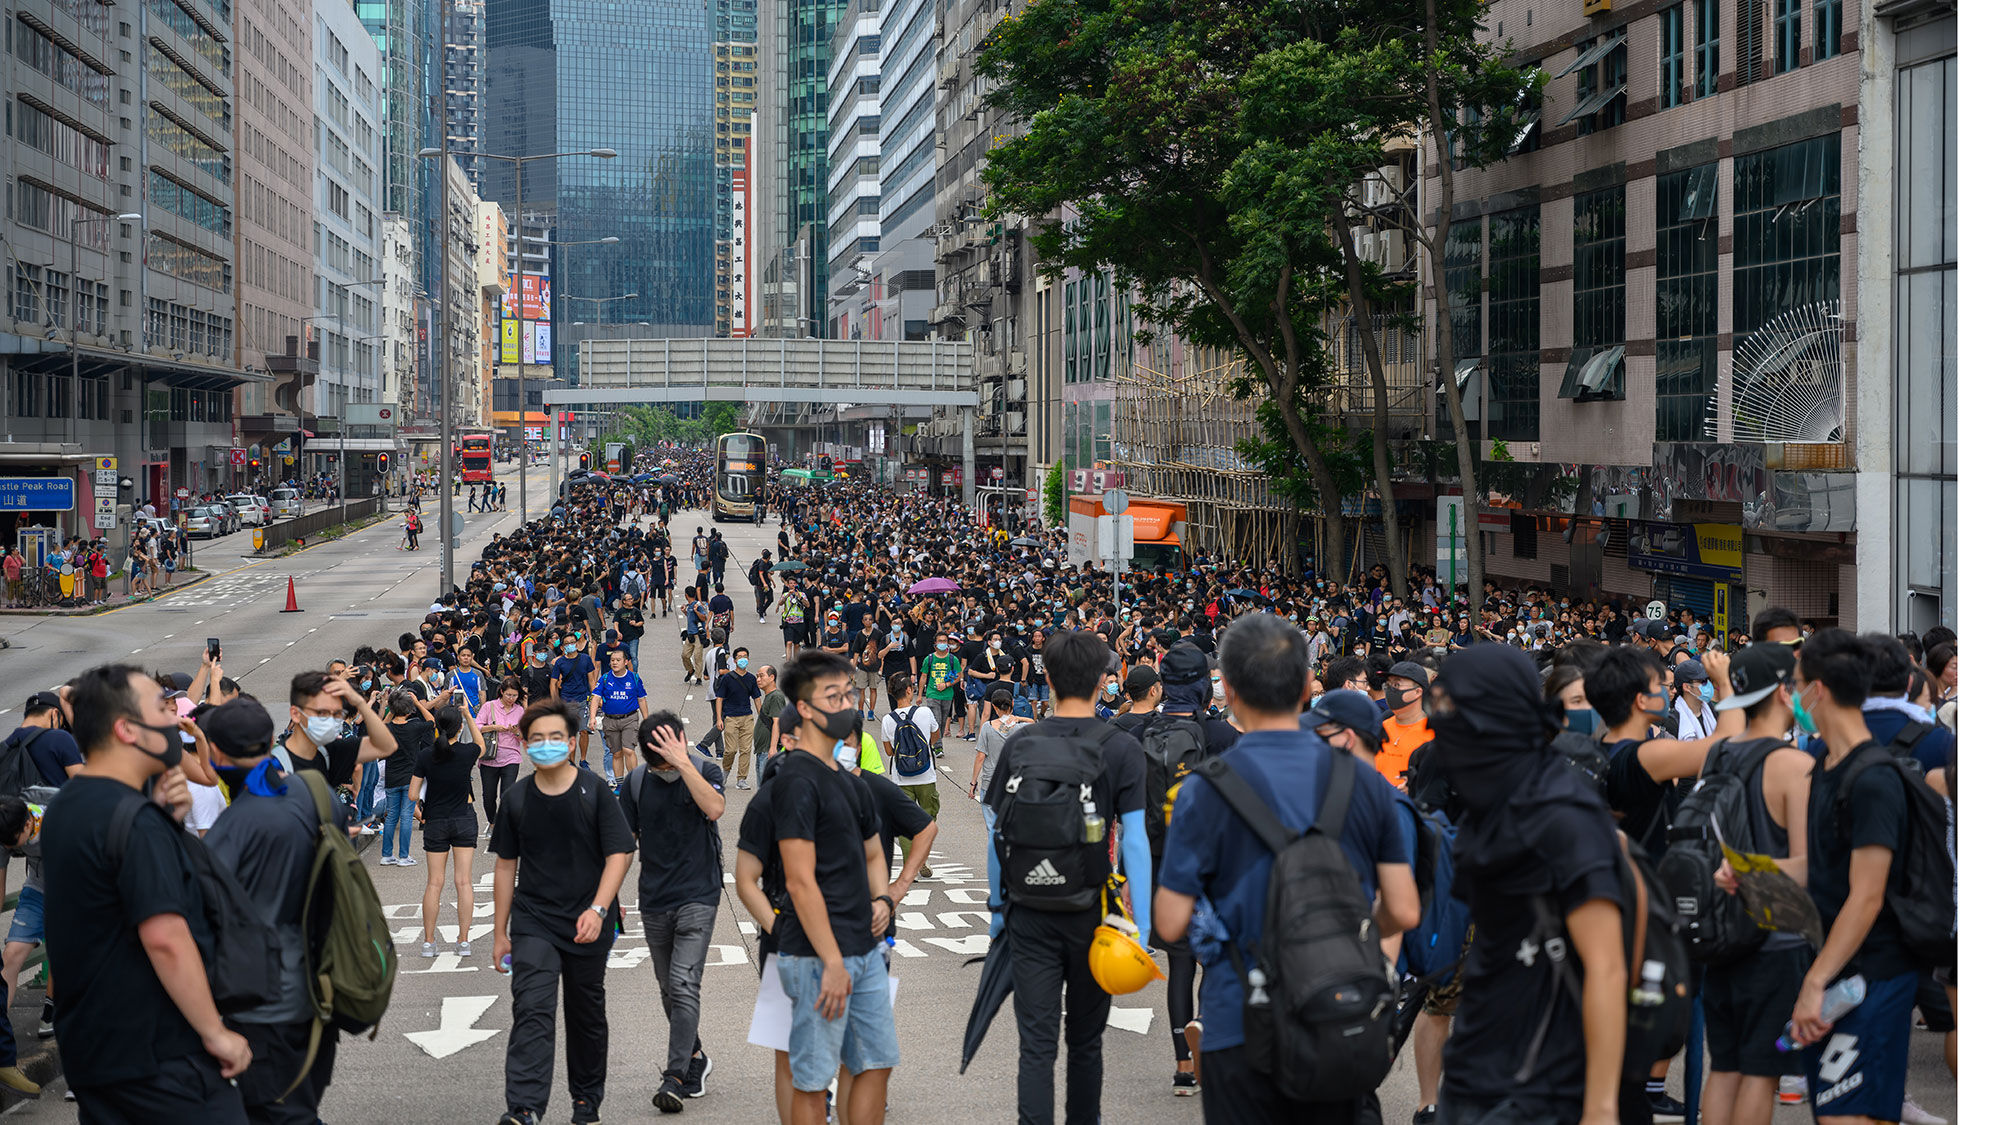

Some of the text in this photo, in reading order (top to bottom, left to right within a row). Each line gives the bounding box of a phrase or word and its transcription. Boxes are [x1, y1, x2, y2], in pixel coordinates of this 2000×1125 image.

[0, 482, 69, 491] stle Peak Road
[3, 494, 28, 506] 山道
[1647, 606, 1662, 619] 75
[1024, 875, 1067, 886] adidas
